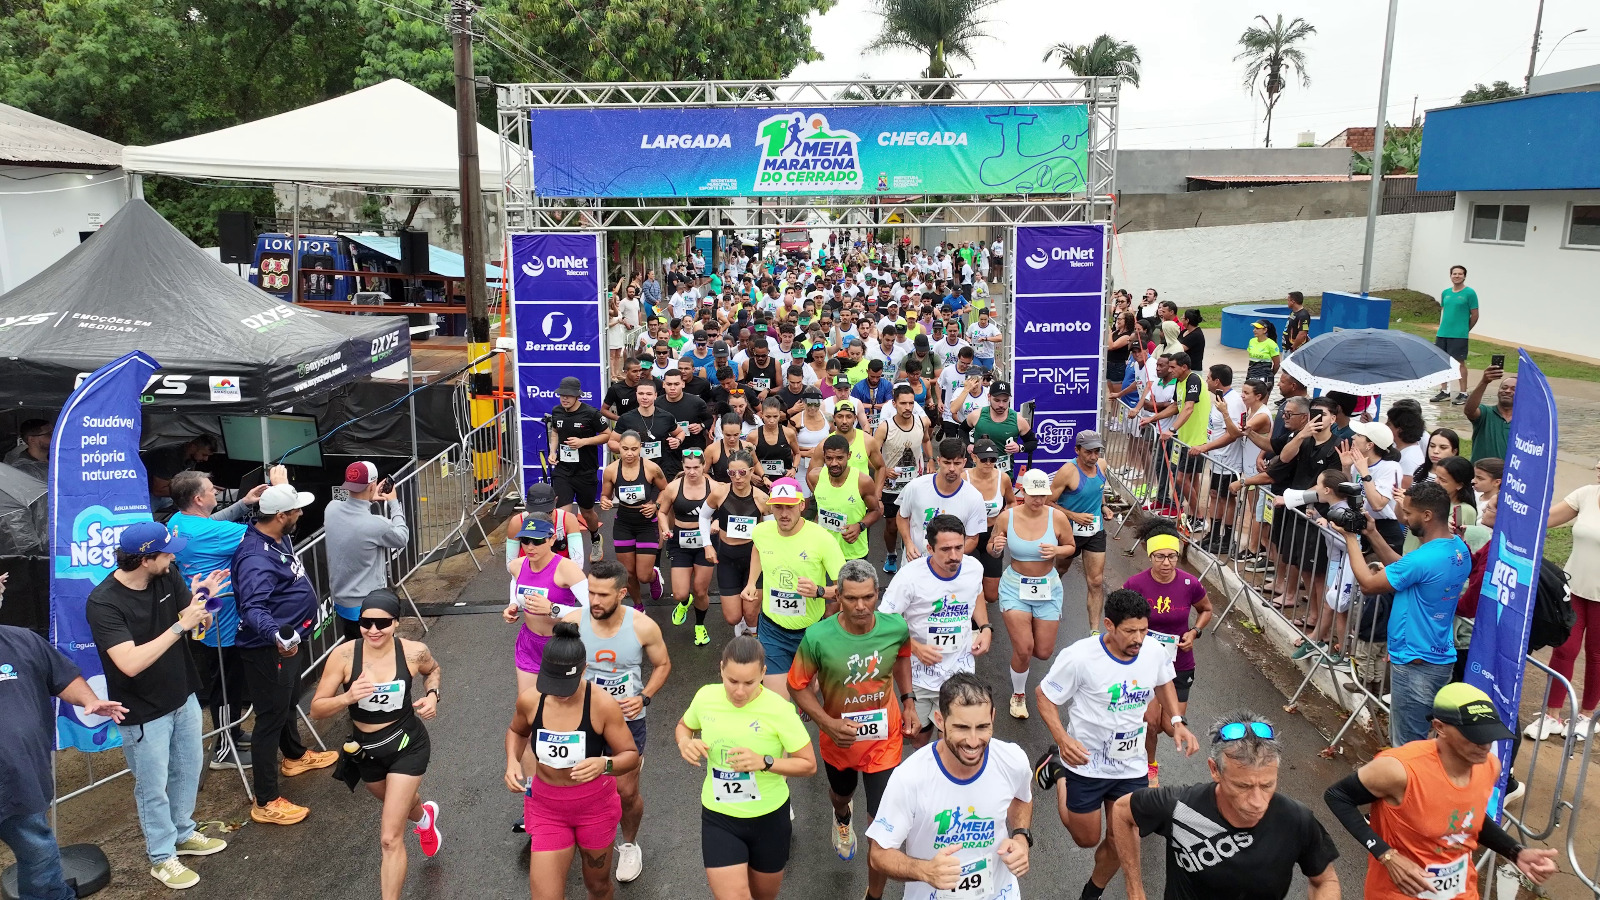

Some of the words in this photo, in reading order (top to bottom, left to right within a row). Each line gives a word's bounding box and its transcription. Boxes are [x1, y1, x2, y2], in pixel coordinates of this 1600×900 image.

[640, 134, 731, 149] LARGADA
[877, 131, 968, 147] CHEGADA
[801, 141, 853, 157] MEIA
[763, 158, 855, 171] MARATONA
[761, 171, 784, 183] DO
[786, 170, 858, 182] CERRADO
[1051, 247, 1094, 260] OnNet
[546, 256, 588, 269] OnNet
[72, 312, 132, 325] EMOÇÕES
[241, 304, 296, 330] OXYS
[1024, 320, 1092, 333] Aramoto
[370, 330, 400, 356] OXYS
[525, 340, 591, 352] Bernardão
[1022, 367, 1090, 383] PRIME
[1054, 383, 1089, 395] GYM
[82, 415, 134, 429] Saudável
[1044, 426, 1073, 436] Serra
[81, 432, 107, 447] pela
[1036, 434, 1070, 446] Negra
[80, 448, 125, 468] própria
[82, 468, 138, 482] natureza
[822, 517, 840, 528] 140
[1078, 524, 1094, 532] 215
[88, 522, 131, 548] Ser
[70, 542, 116, 569] Neg
[1031, 586, 1038, 594] 3
[775, 599, 798, 609] 134
[946, 603, 969, 612] MEIA
[933, 635, 956, 646] 171
[603, 684, 626, 696] 128
[1127, 690, 1150, 698] MEIA
[369, 694, 389, 705] 42
[844, 691, 885, 705] AACREP
[548, 745, 568, 758] 30
[1117, 738, 1138, 752] 201
[723, 782, 743, 794] 12
[960, 820, 994, 833] MEIA
[935, 831, 994, 844] MARATONA
[1174, 832, 1254, 873] adidas
[950, 874, 981, 893] 49
[1433, 874, 1460, 892] 203
